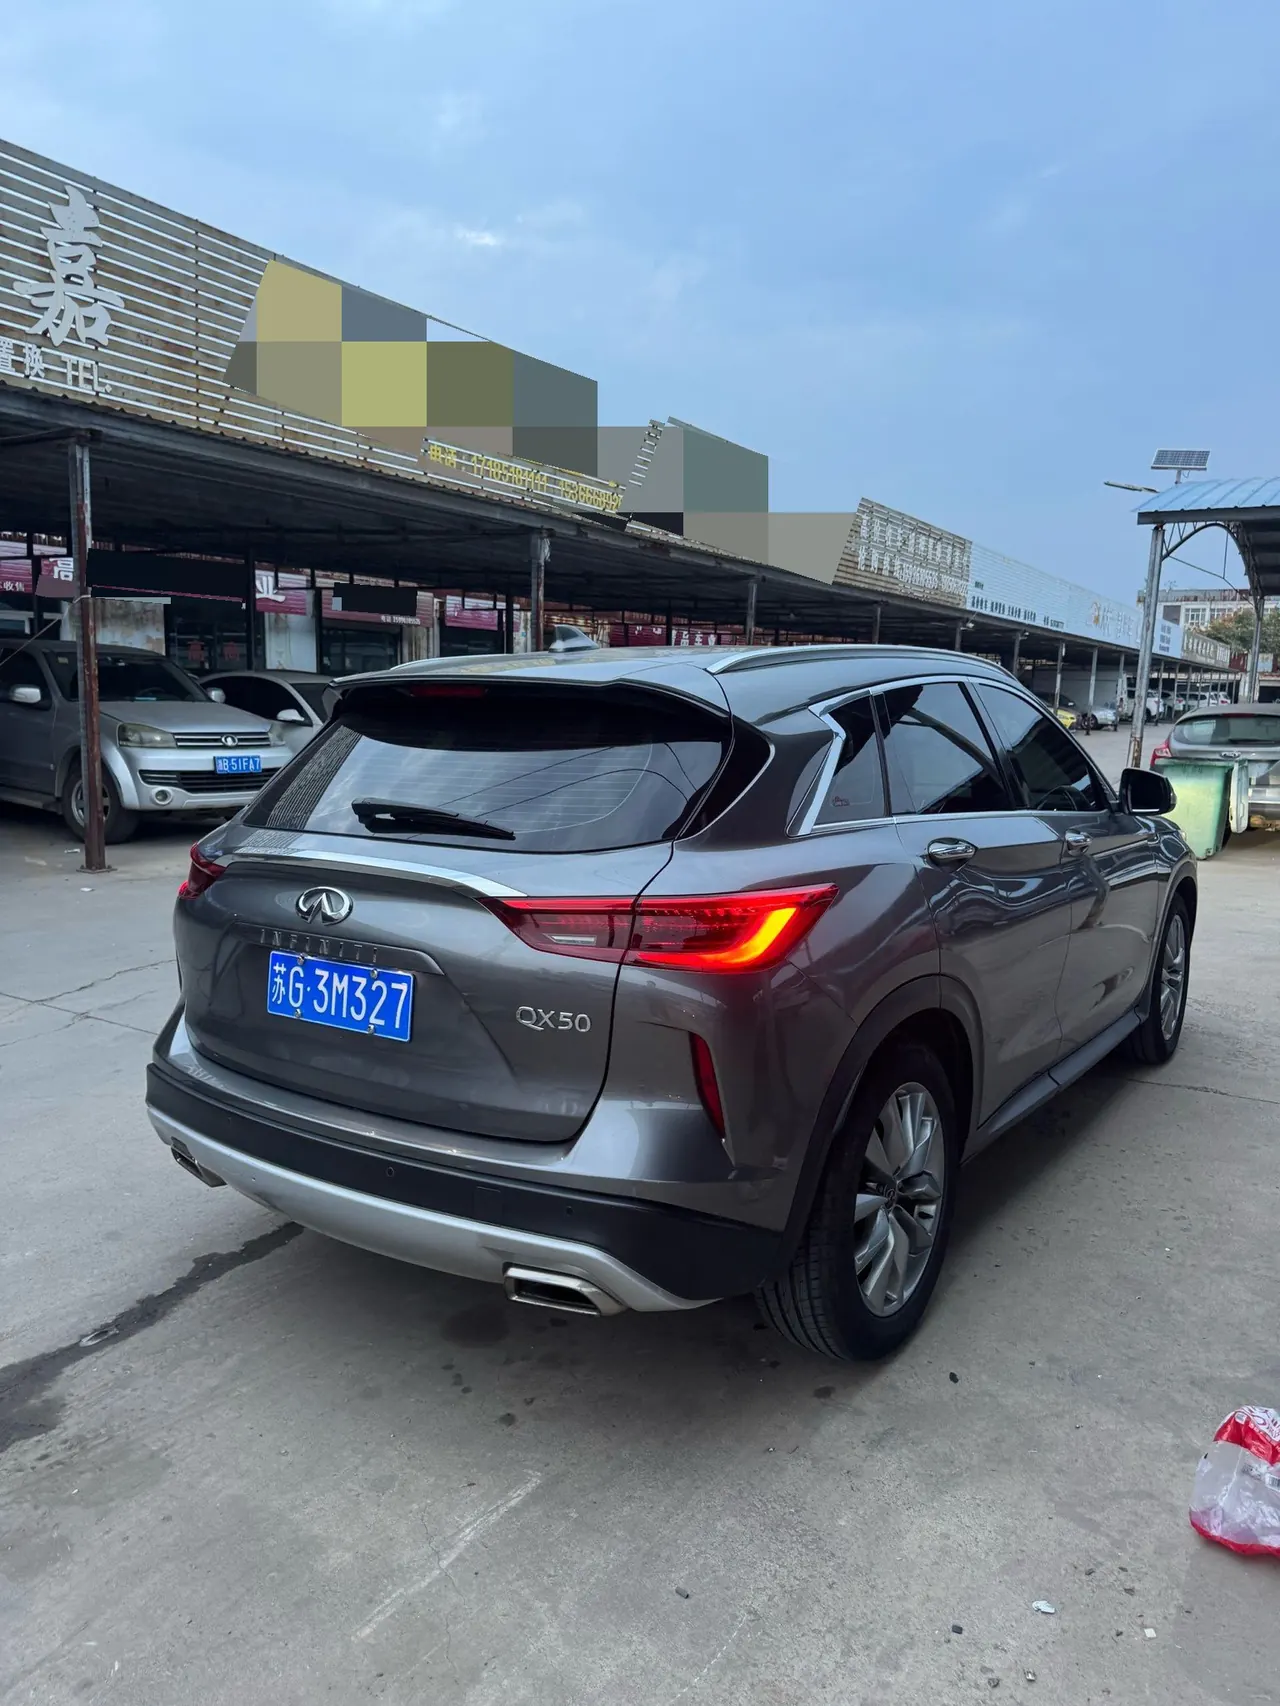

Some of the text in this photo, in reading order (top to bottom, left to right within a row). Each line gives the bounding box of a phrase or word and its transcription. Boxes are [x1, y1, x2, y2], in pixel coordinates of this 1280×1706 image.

[13, 185, 125, 347] 嘉
[260, 928, 379, 964] INFINITI
[516, 1006, 592, 1033] QX50
